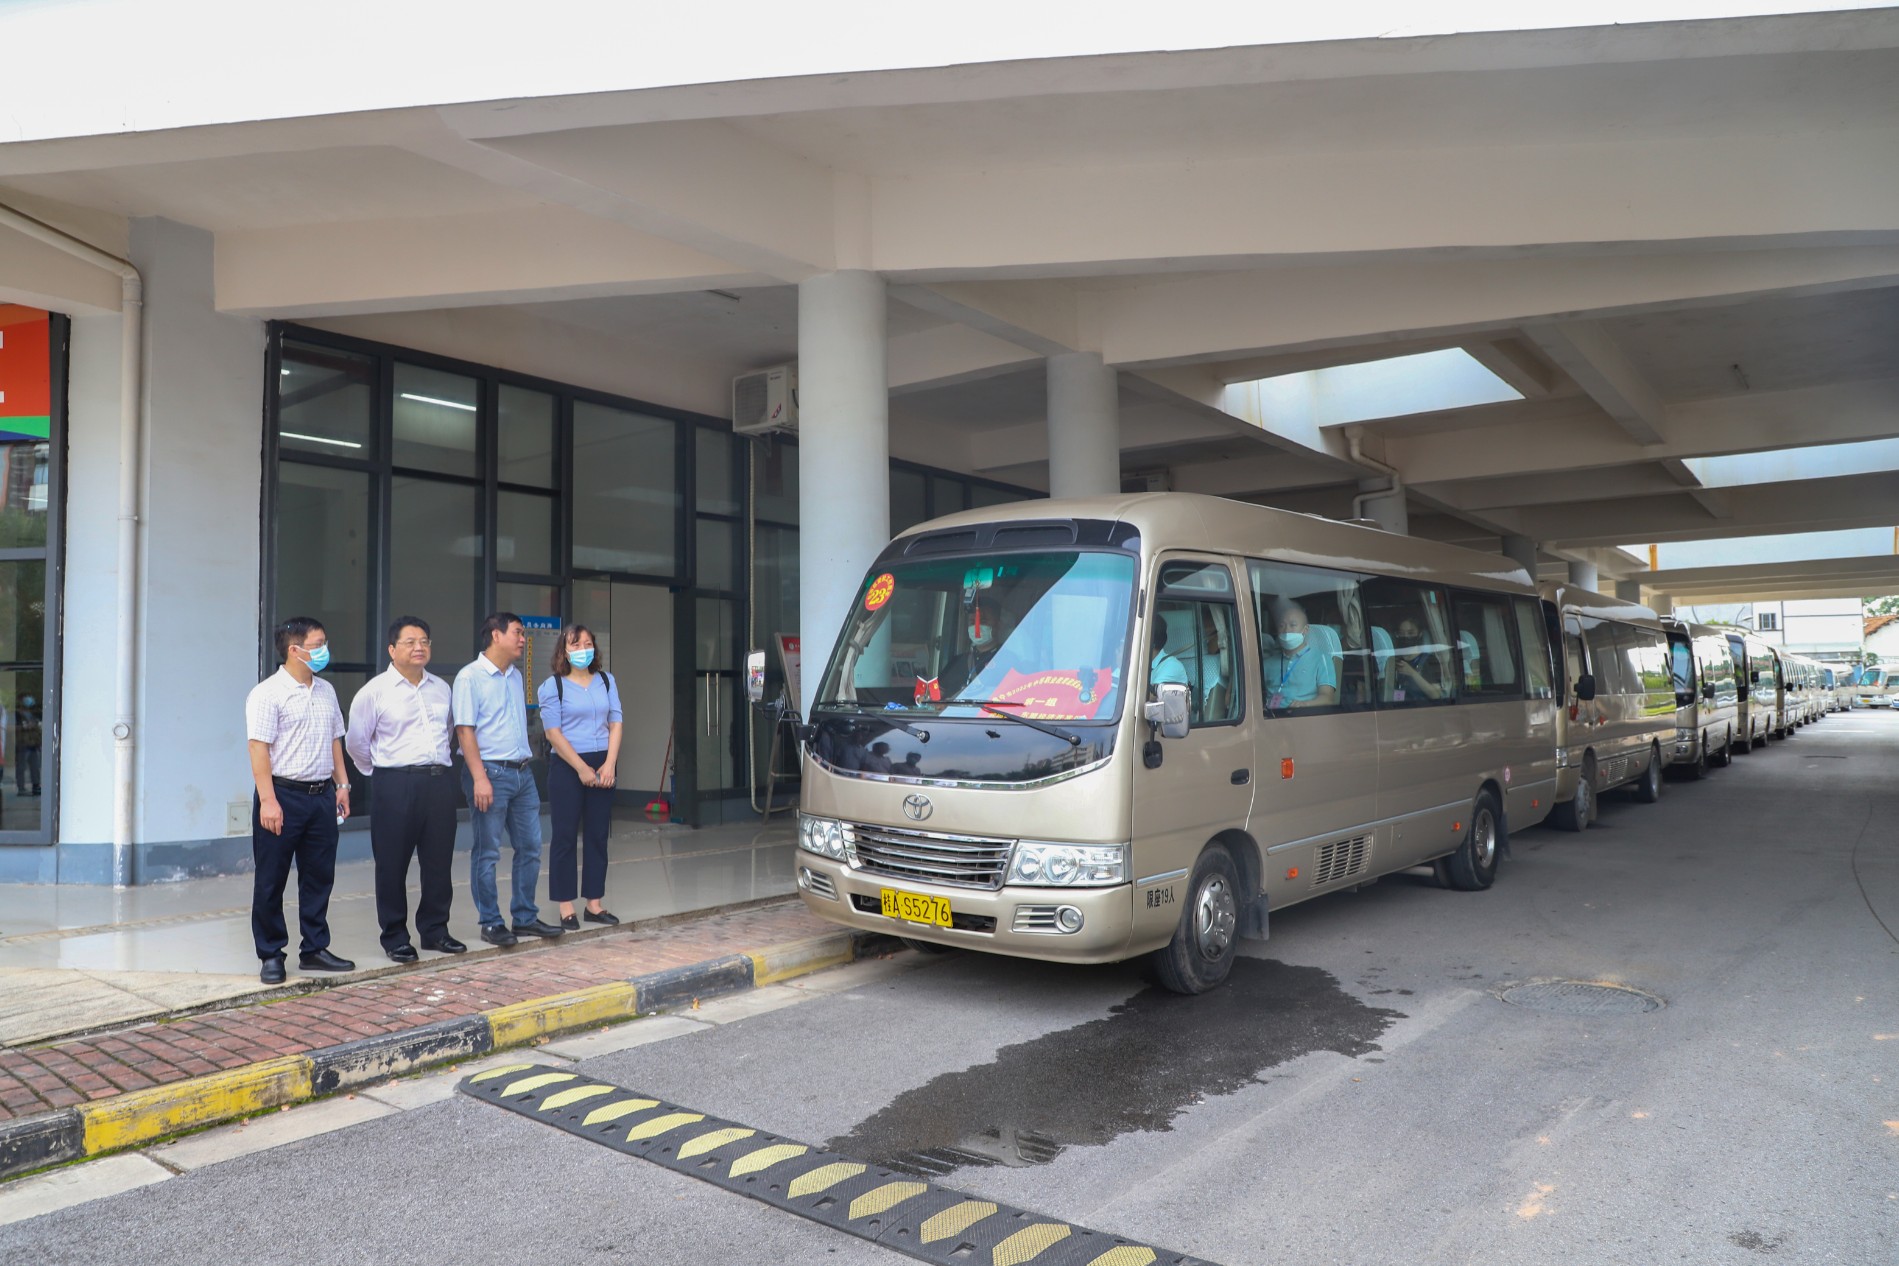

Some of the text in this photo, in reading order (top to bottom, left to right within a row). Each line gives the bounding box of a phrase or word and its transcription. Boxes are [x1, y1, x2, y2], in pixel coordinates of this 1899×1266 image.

[868, 585, 886, 605] 23
[1024, 697, 1057, 707] 第一组
[1146, 885, 1175, 910] 限座19人
